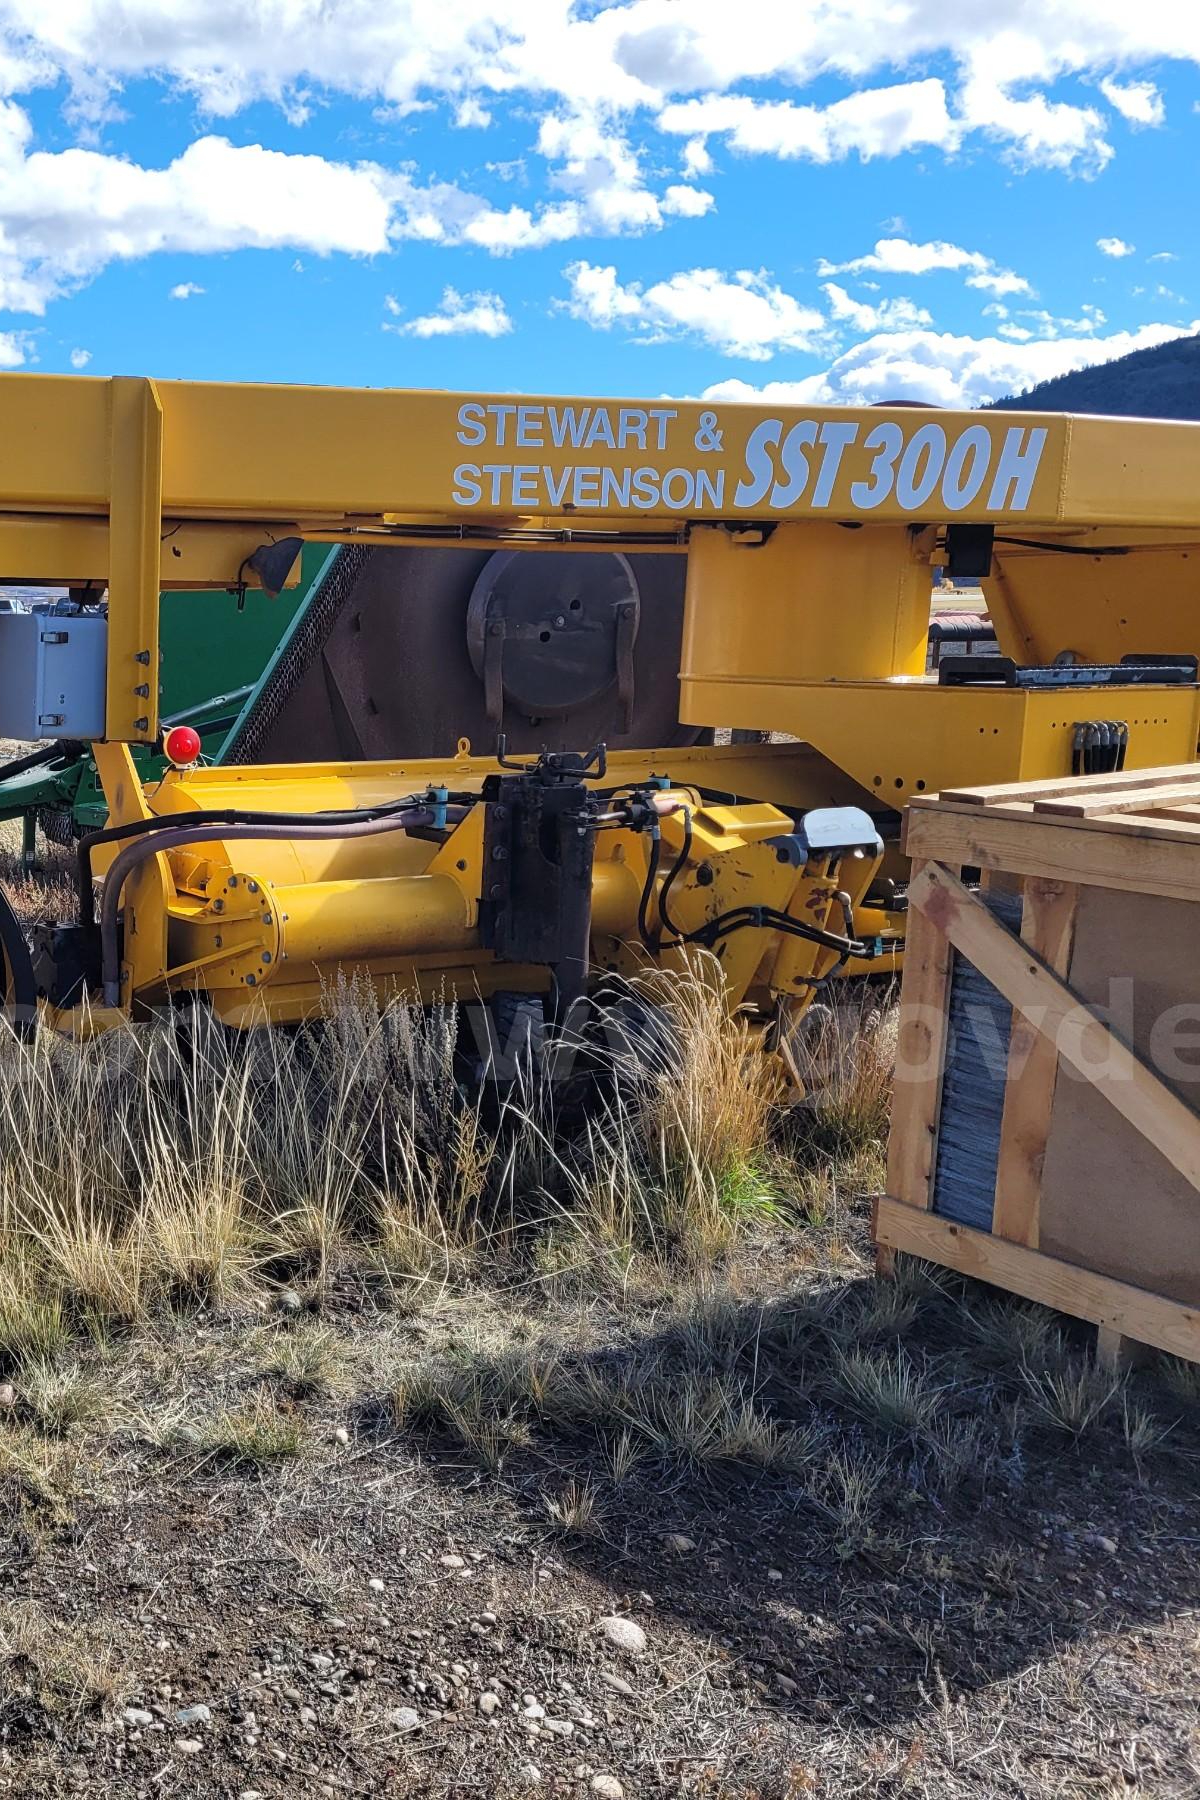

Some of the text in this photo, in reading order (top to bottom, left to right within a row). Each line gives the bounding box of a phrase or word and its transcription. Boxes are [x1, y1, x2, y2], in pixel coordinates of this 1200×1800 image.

[456, 403, 724, 451] STEWART &
[451, 463, 725, 509] STEVENSON
